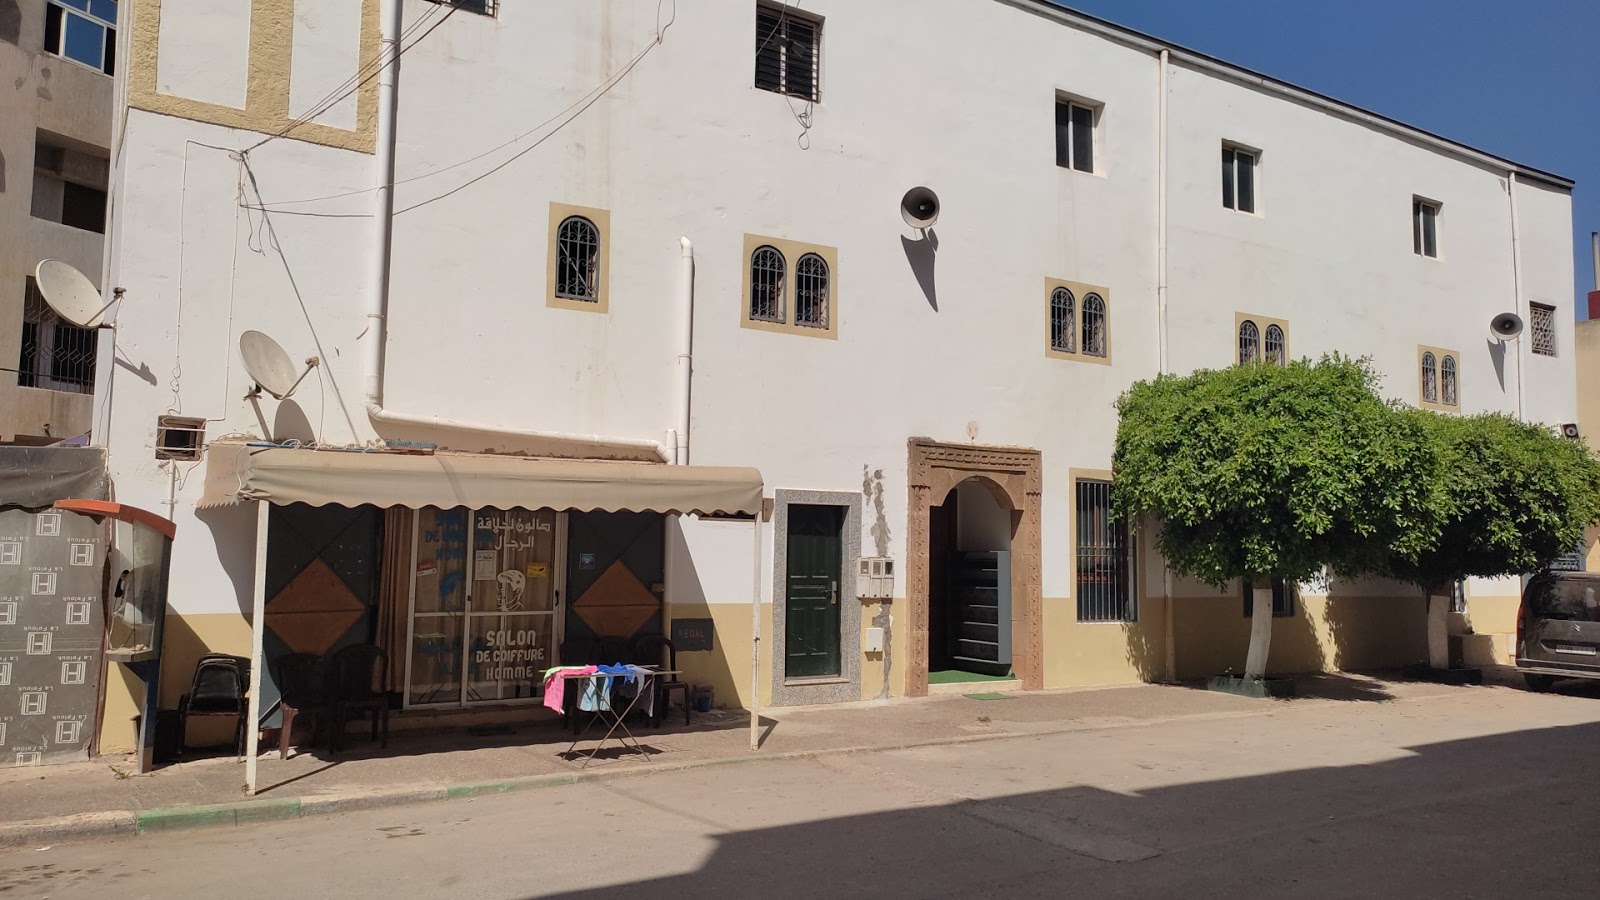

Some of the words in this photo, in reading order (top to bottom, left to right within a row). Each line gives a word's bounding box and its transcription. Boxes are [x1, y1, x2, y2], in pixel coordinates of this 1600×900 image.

[516, 518, 550, 532] صالون
[494, 535, 534, 552] الرجال
[486, 630, 536, 646] SALON
[476, 650, 490, 663] DE
[493, 648, 544, 662] COIFFURE
[486, 666, 533, 681] HOMME
